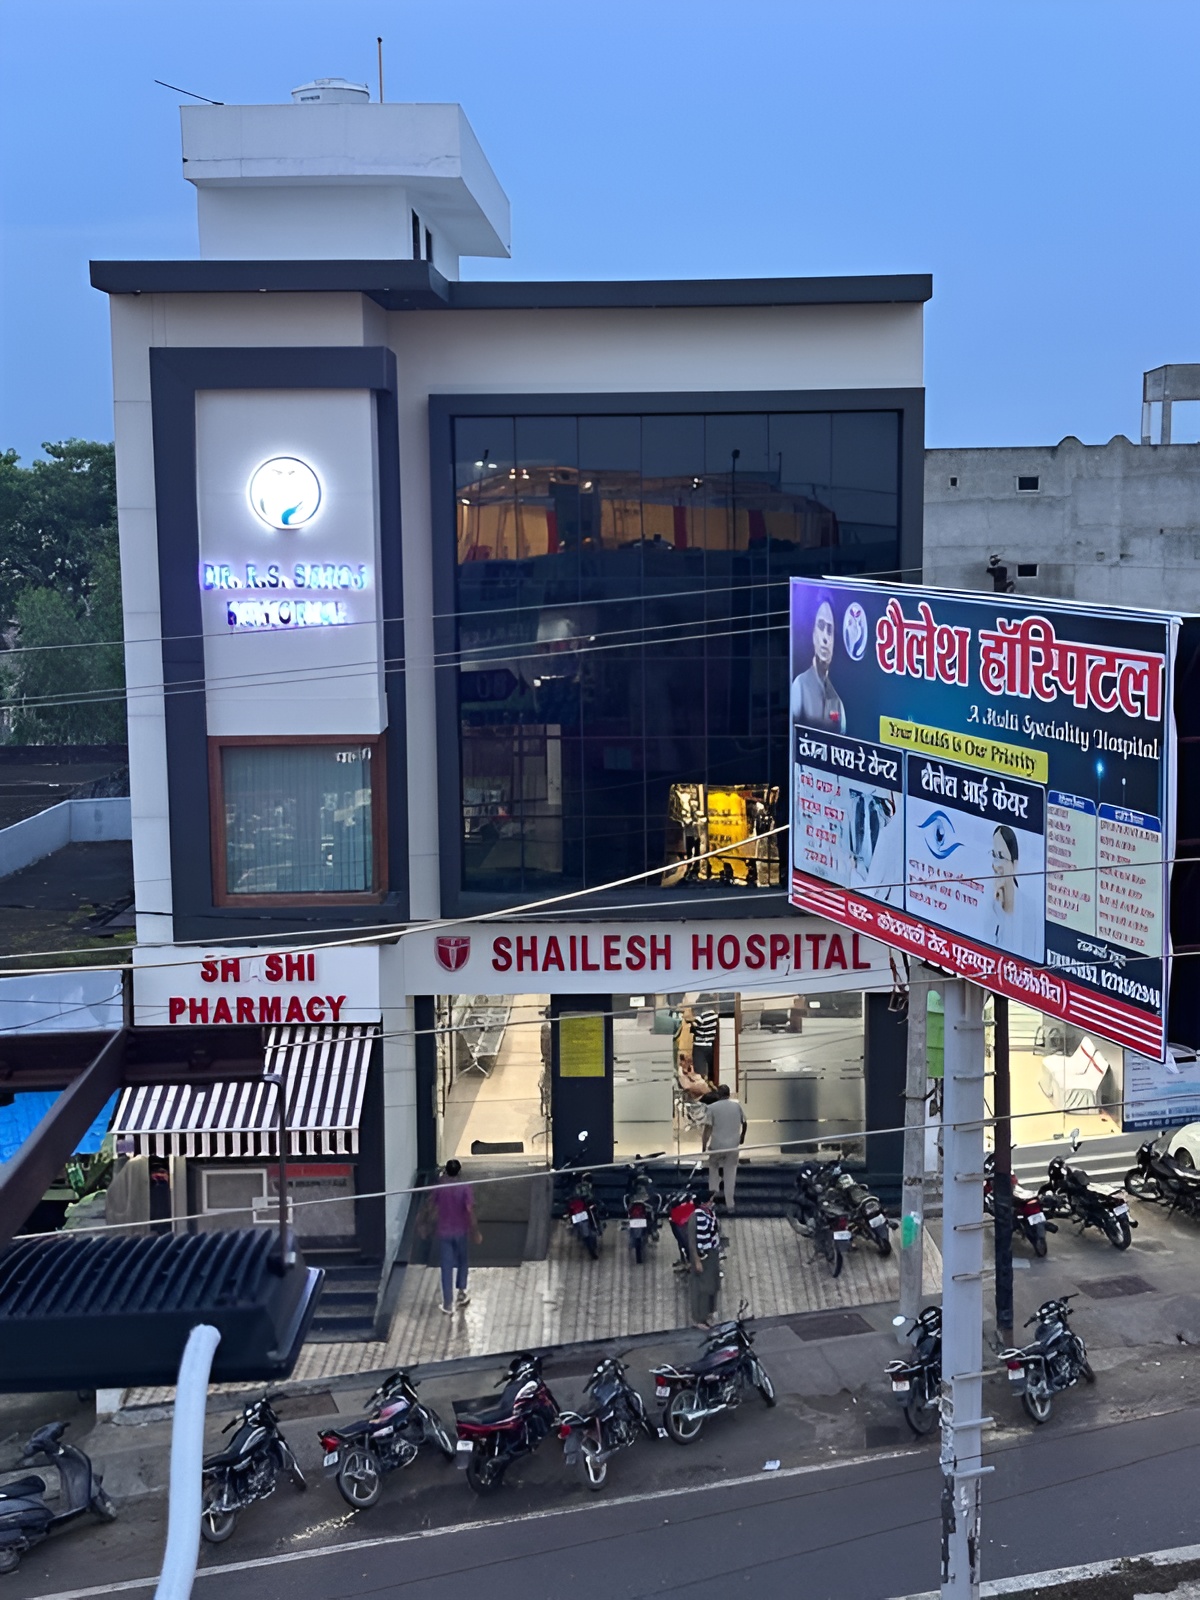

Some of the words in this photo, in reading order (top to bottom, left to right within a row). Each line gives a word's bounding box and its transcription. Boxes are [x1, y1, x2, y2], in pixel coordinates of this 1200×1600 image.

[876, 597, 971, 686] शैलेश
[979, 615, 1165, 721] हॉस्पिटल
[982, 708, 1019, 731] Multi
[1022, 714, 1090, 752] Speciality
[1094, 728, 1161, 760] Hospital
[991, 745, 1036, 778] Priority
[961, 777, 988, 811] आई
[992, 781, 1029, 819] केयर
[491, 934, 672, 972] SHAILESH
[691, 933, 871, 971] HOSPITAL
[168, 995, 347, 1025] PHARMACY
